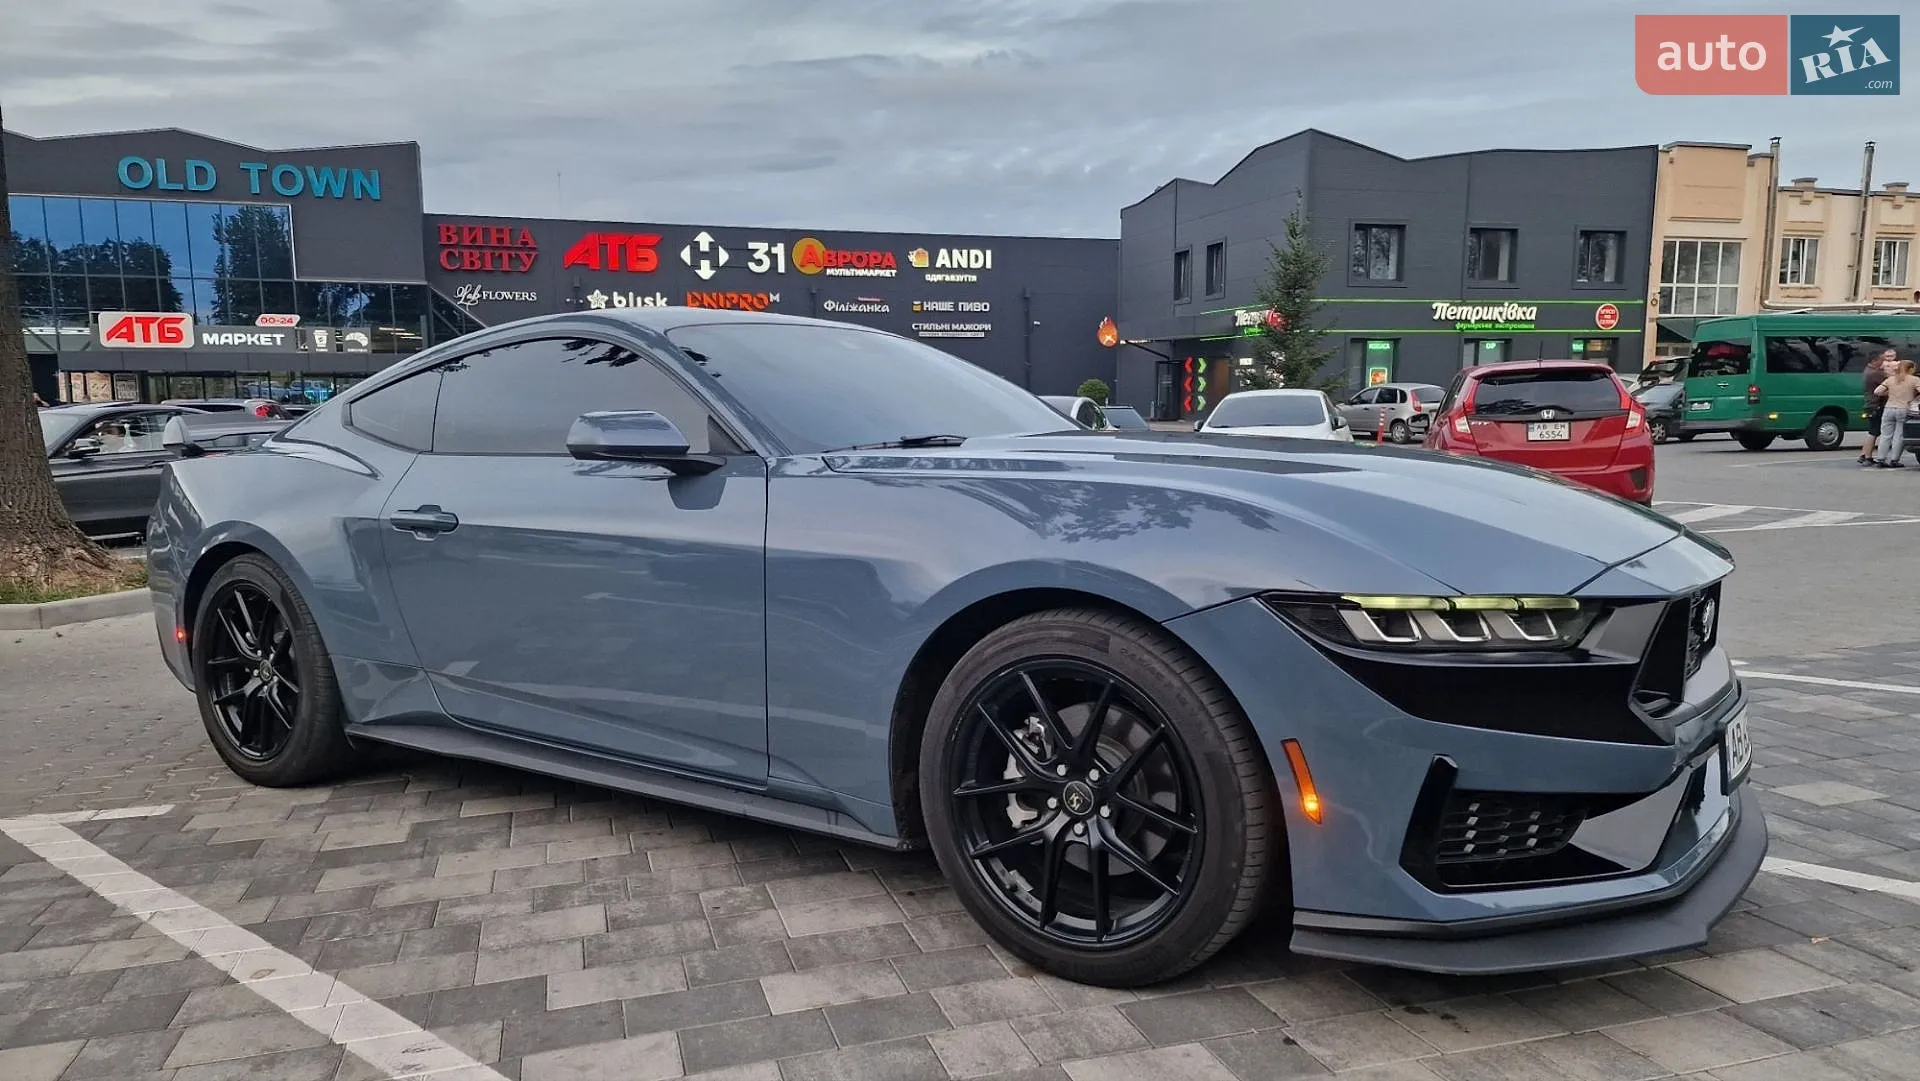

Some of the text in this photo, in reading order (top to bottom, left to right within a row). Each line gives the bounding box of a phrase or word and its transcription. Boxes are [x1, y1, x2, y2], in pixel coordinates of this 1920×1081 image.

[117, 155, 381, 200] OLD TOWN
[437, 224, 537, 248] ВИНА
[439, 248, 538, 272] СВІТУ
[747, 242, 786, 273] 31
[935, 248, 992, 269] ANDI
[825, 267, 897, 277] МУЛЬТИМАРКЕТ
[482, 290, 537, 301] FLOWERS
[612, 291, 668, 307] blisk
[824, 299, 890, 313] Філіжанка
[923, 301, 990, 312] НАШЕ ПИВО
[1431, 301, 1537, 324] Петриківка
[260, 317, 293, 325] 00-24
[951, 323, 992, 331] МАЖОРИ
[202, 332, 285, 346] МАРКЕТ
[1539, 431, 1563, 439] 6554
